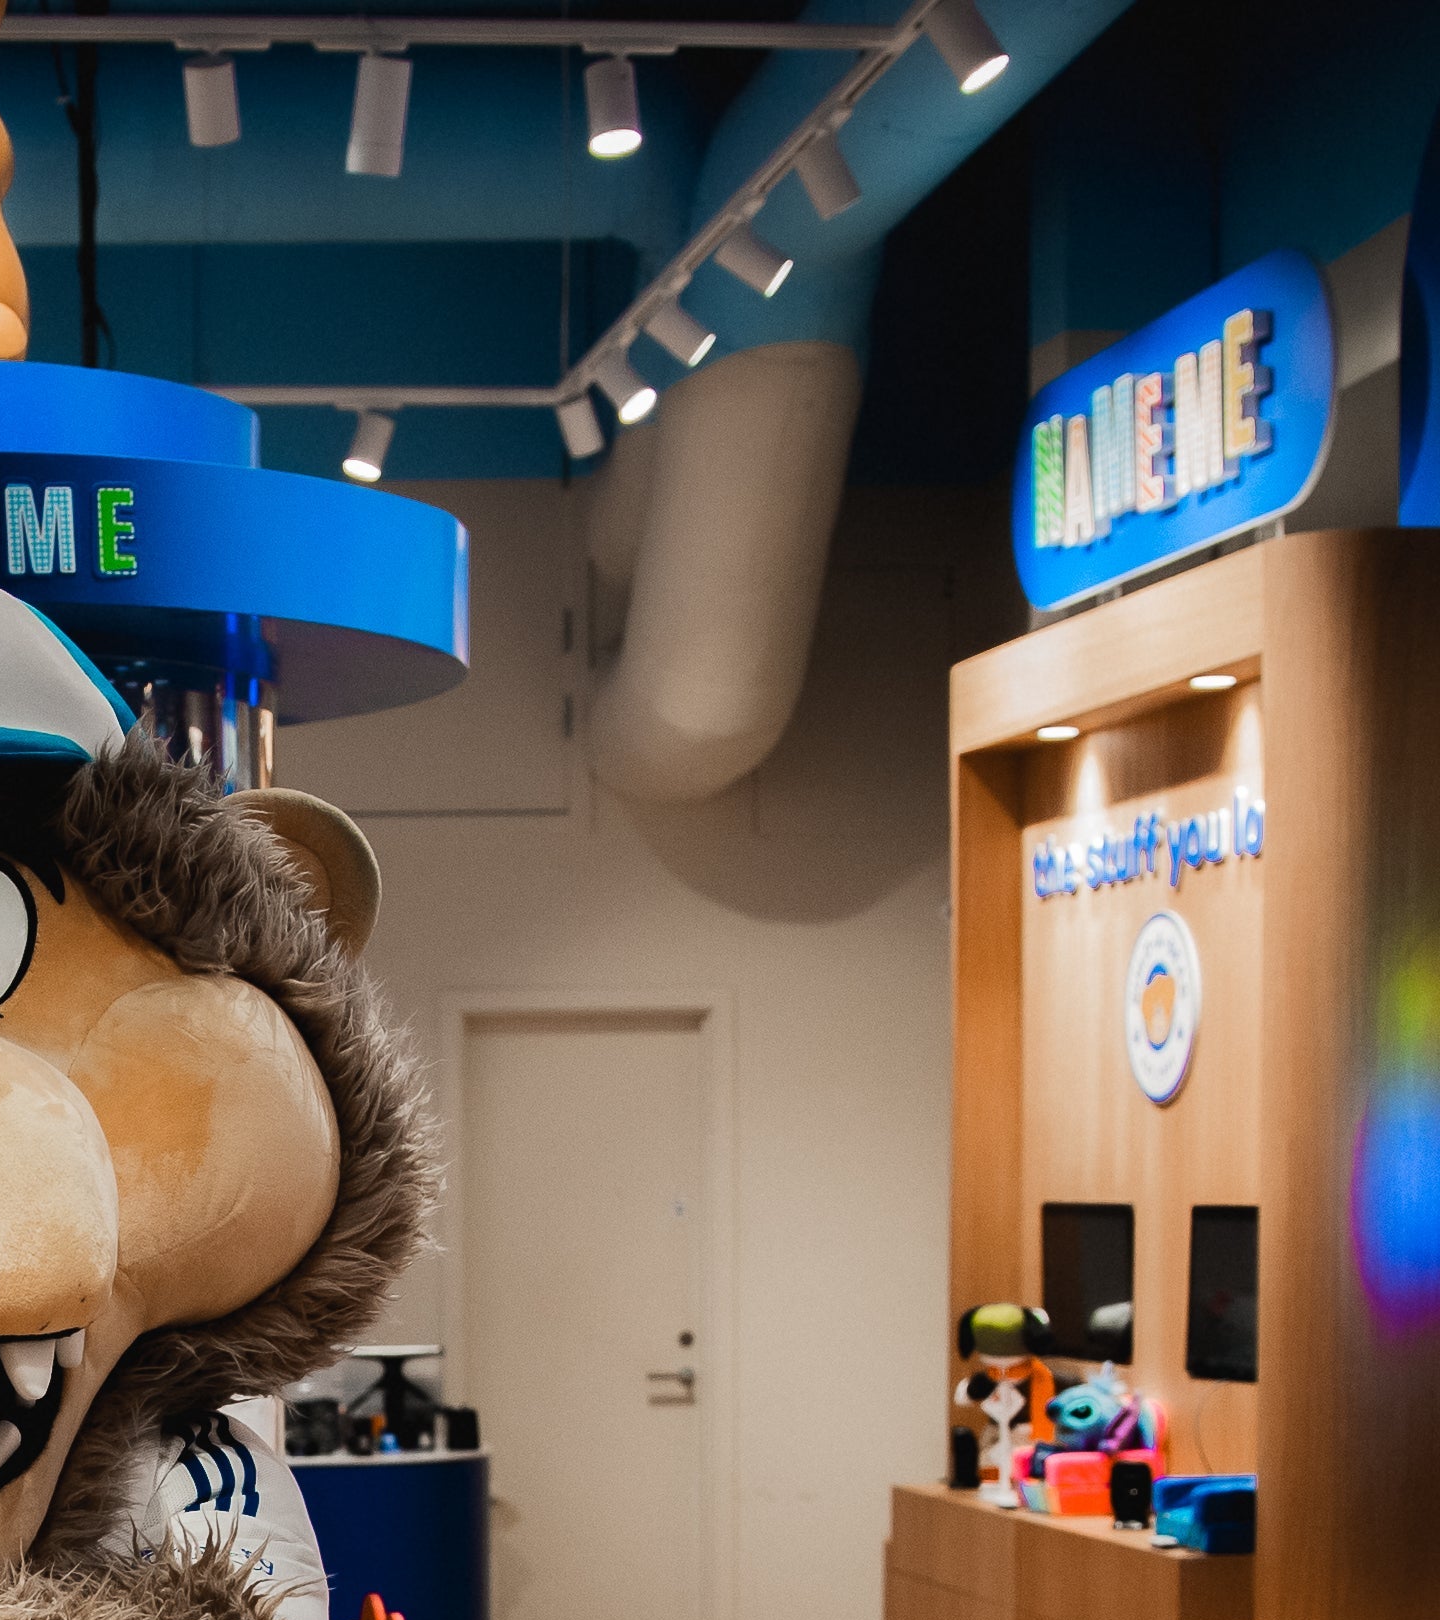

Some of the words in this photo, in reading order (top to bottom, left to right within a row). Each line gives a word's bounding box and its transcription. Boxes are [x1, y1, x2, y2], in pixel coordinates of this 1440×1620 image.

[1174, 308, 1258, 498] ME
[3, 483, 138, 577] ME
[1034, 833, 1083, 897] the
[1086, 811, 1162, 889] stuff
[1167, 809, 1231, 887] you
